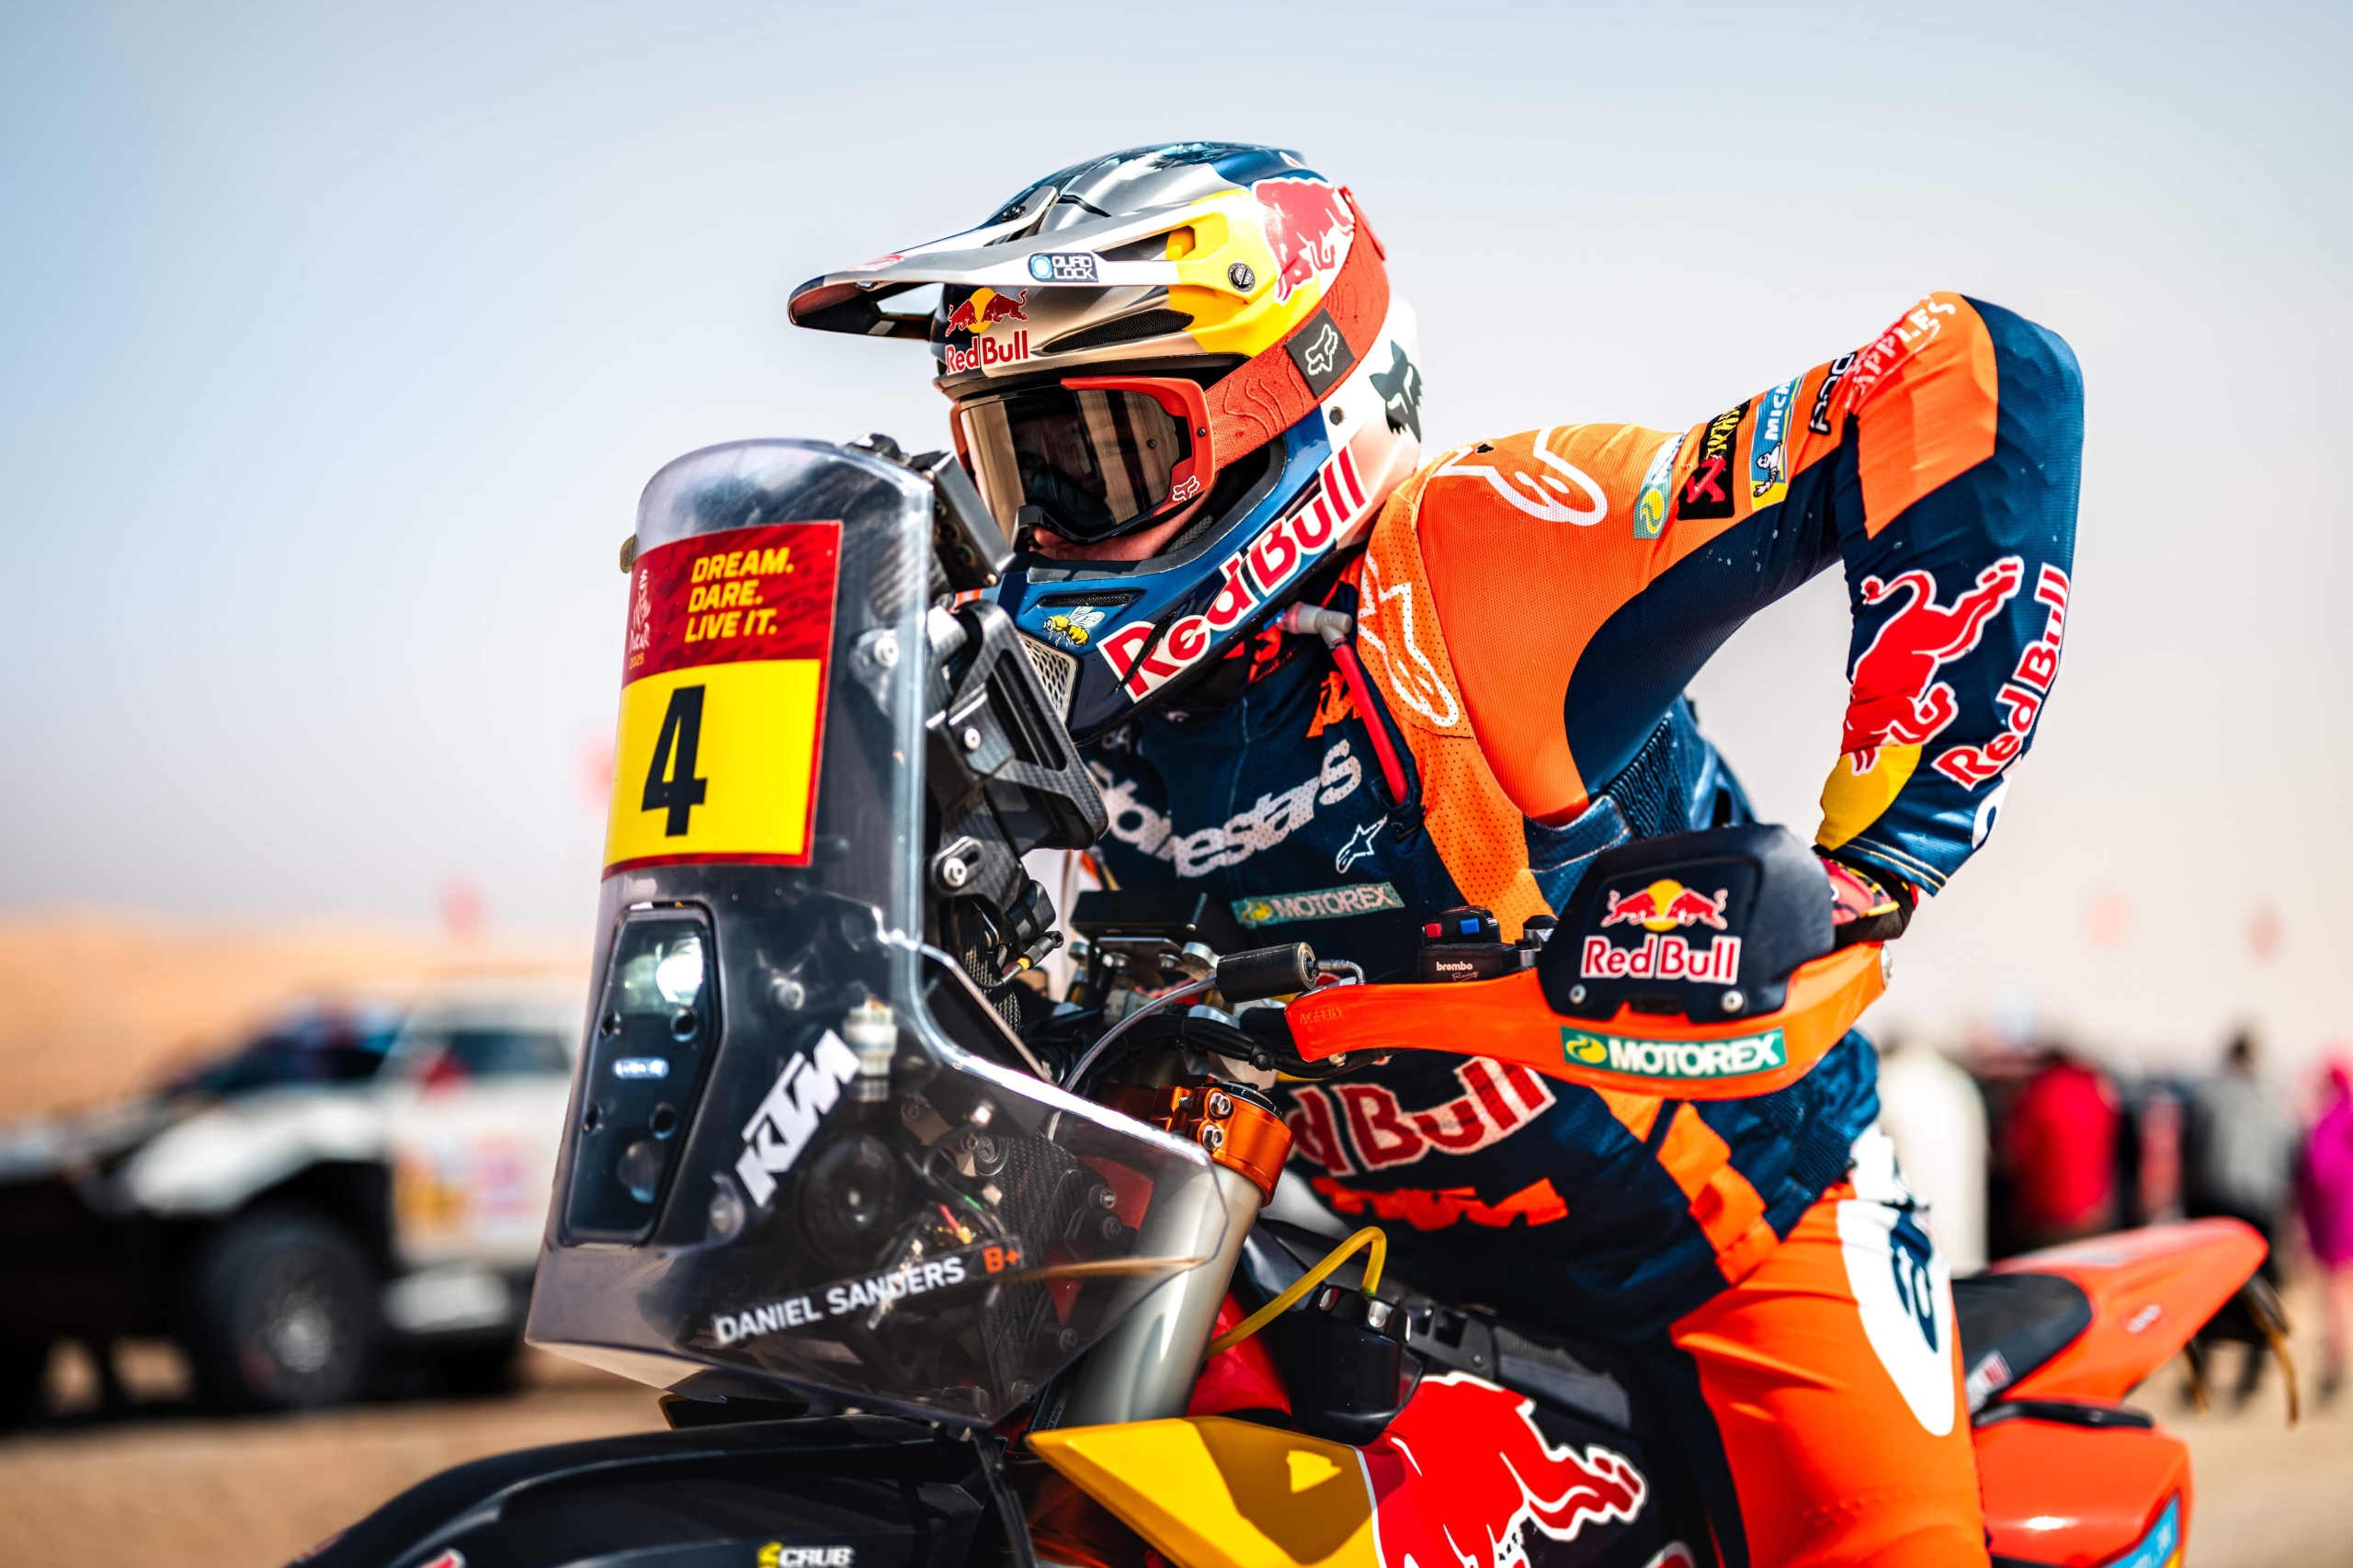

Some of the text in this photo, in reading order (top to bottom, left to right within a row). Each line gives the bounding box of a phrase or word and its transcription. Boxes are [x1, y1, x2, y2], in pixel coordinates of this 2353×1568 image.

[1051, 256, 1092, 267] QUAD
[1053, 267, 1094, 279] LOCK
[946, 329, 1029, 374] Red Bull
[691, 547, 794, 584] DREAM.
[1097, 442, 1370, 701] Red Bull
[688, 579, 763, 613] DARE.
[685, 608, 778, 642] LIVE IT.
[1931, 562, 2070, 791] Red Bull
[641, 685, 707, 836] 4
[1271, 884, 1394, 919] MOTOREX
[1436, 961, 1473, 971] brembo
[1581, 934, 1742, 984] Red Bull
[1609, 1032, 1780, 1078] MOTOREX
[735, 1028, 860, 1207] KTM
[1331, 1057, 1557, 1172] Bull
[983, 1246, 1019, 1274] B+
[714, 1256, 966, 1346] DANIEL SANDERS
